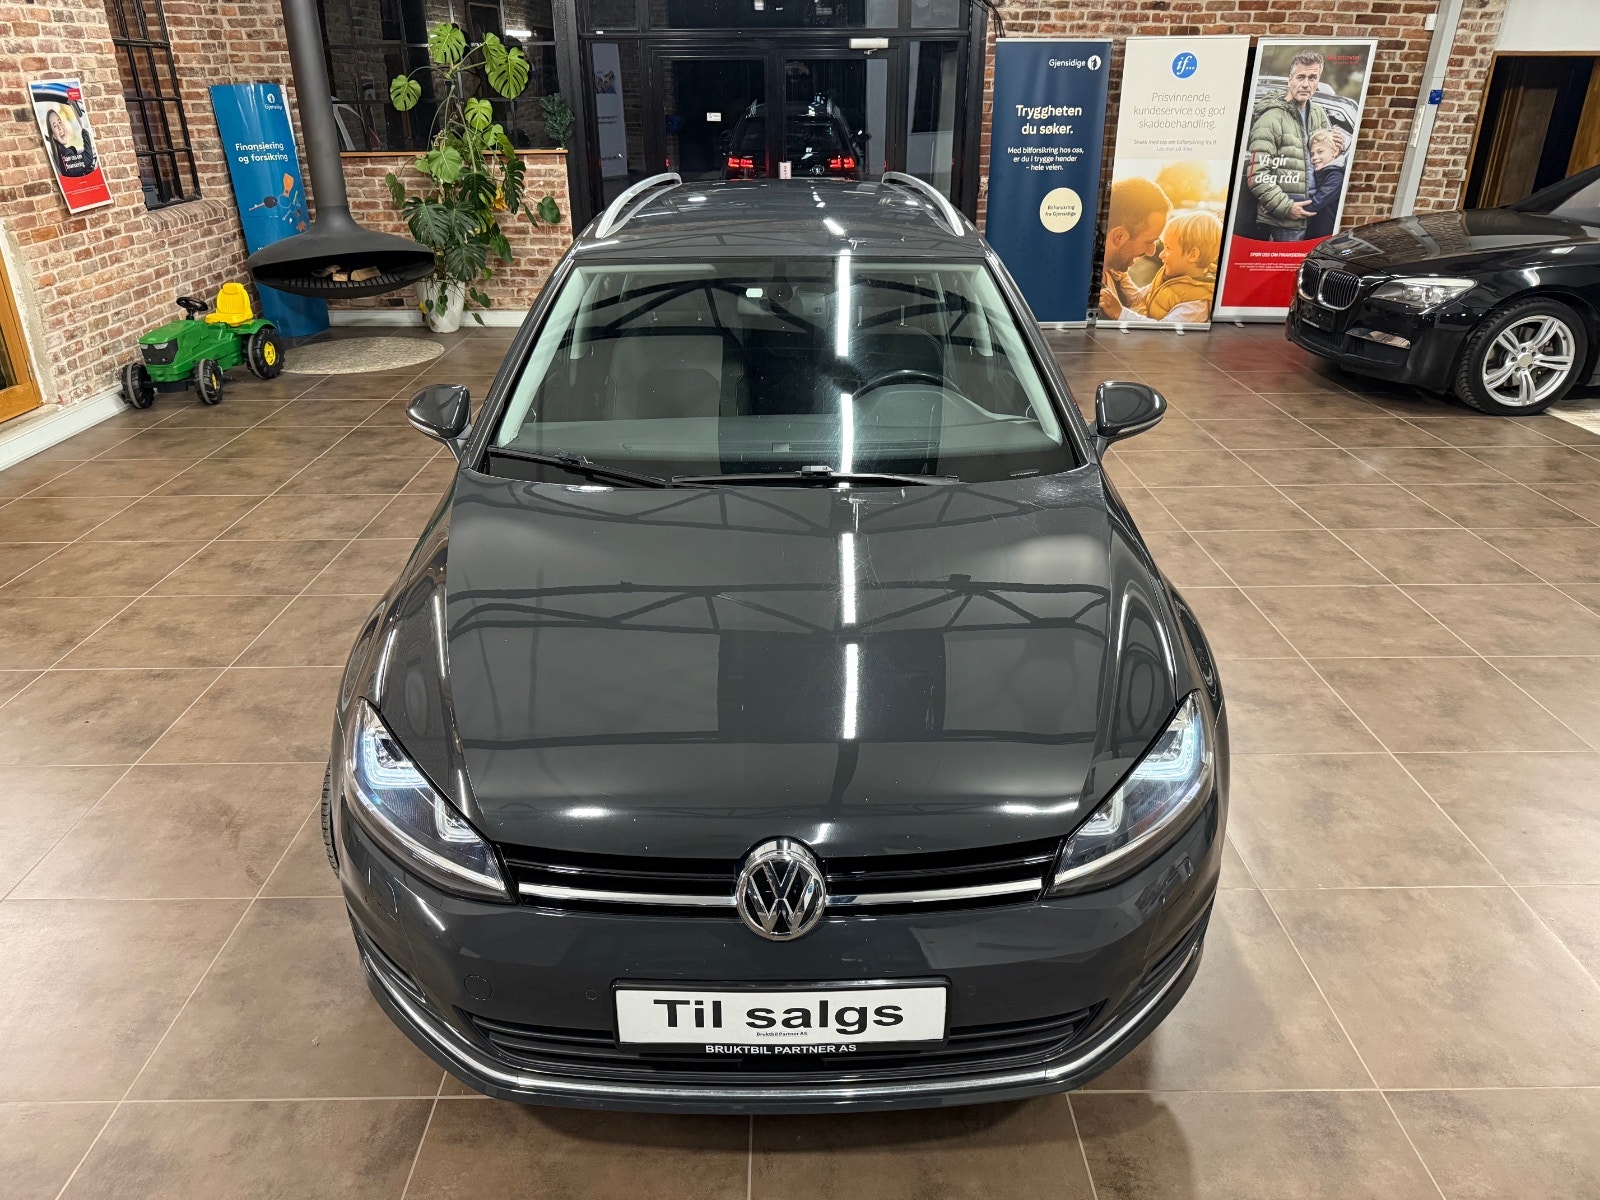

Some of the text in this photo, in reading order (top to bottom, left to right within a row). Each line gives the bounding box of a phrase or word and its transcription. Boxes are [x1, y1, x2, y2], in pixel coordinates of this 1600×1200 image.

[1048, 58, 1086, 69] Gjensidige
[1151, 92, 1211, 102] Prisvinnende
[1015, 104, 1082, 119] Tryggheten
[1133, 105, 1226, 118] kundeservice og god
[1021, 123, 1074, 135] du søker.
[235, 141, 284, 152] Finansiering
[1007, 146, 1084, 155] Med bilforsikring hos oss,
[238, 153, 288, 164] og forsikring
[1034, 156, 1054, 164] trygge
[1258, 154, 1289, 169] Vi gir
[1254, 171, 1301, 187] deg råd
[653, 999, 904, 1035] Til salgs
[705, 1043, 857, 1055] BRUKTBIL PARTNER AS
